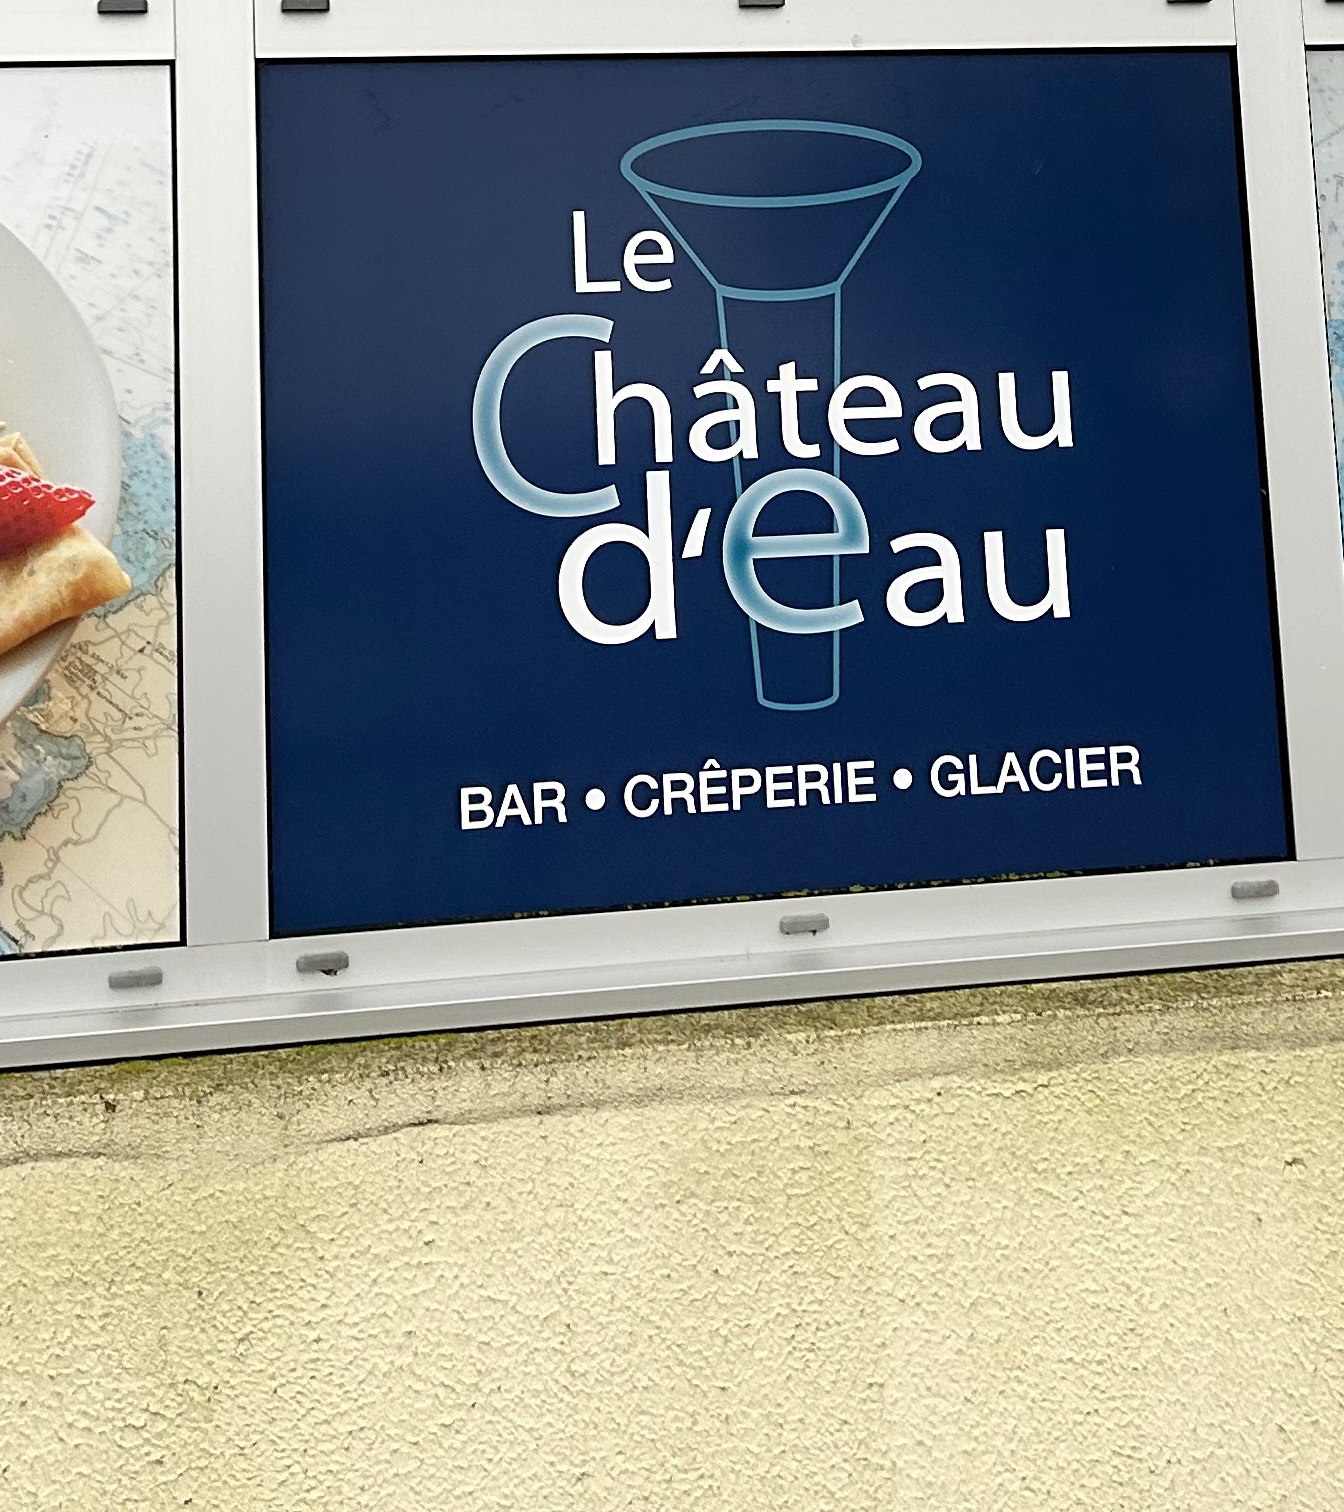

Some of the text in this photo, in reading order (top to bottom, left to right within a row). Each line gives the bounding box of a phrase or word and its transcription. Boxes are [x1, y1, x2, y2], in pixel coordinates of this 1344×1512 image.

[572, 210, 675, 294] Le
[472, 313, 1074, 518] Château
[558, 468, 1072, 645] d'eau
[460, 745, 1143, 830] BAR CRÊPERIE GLACIER
